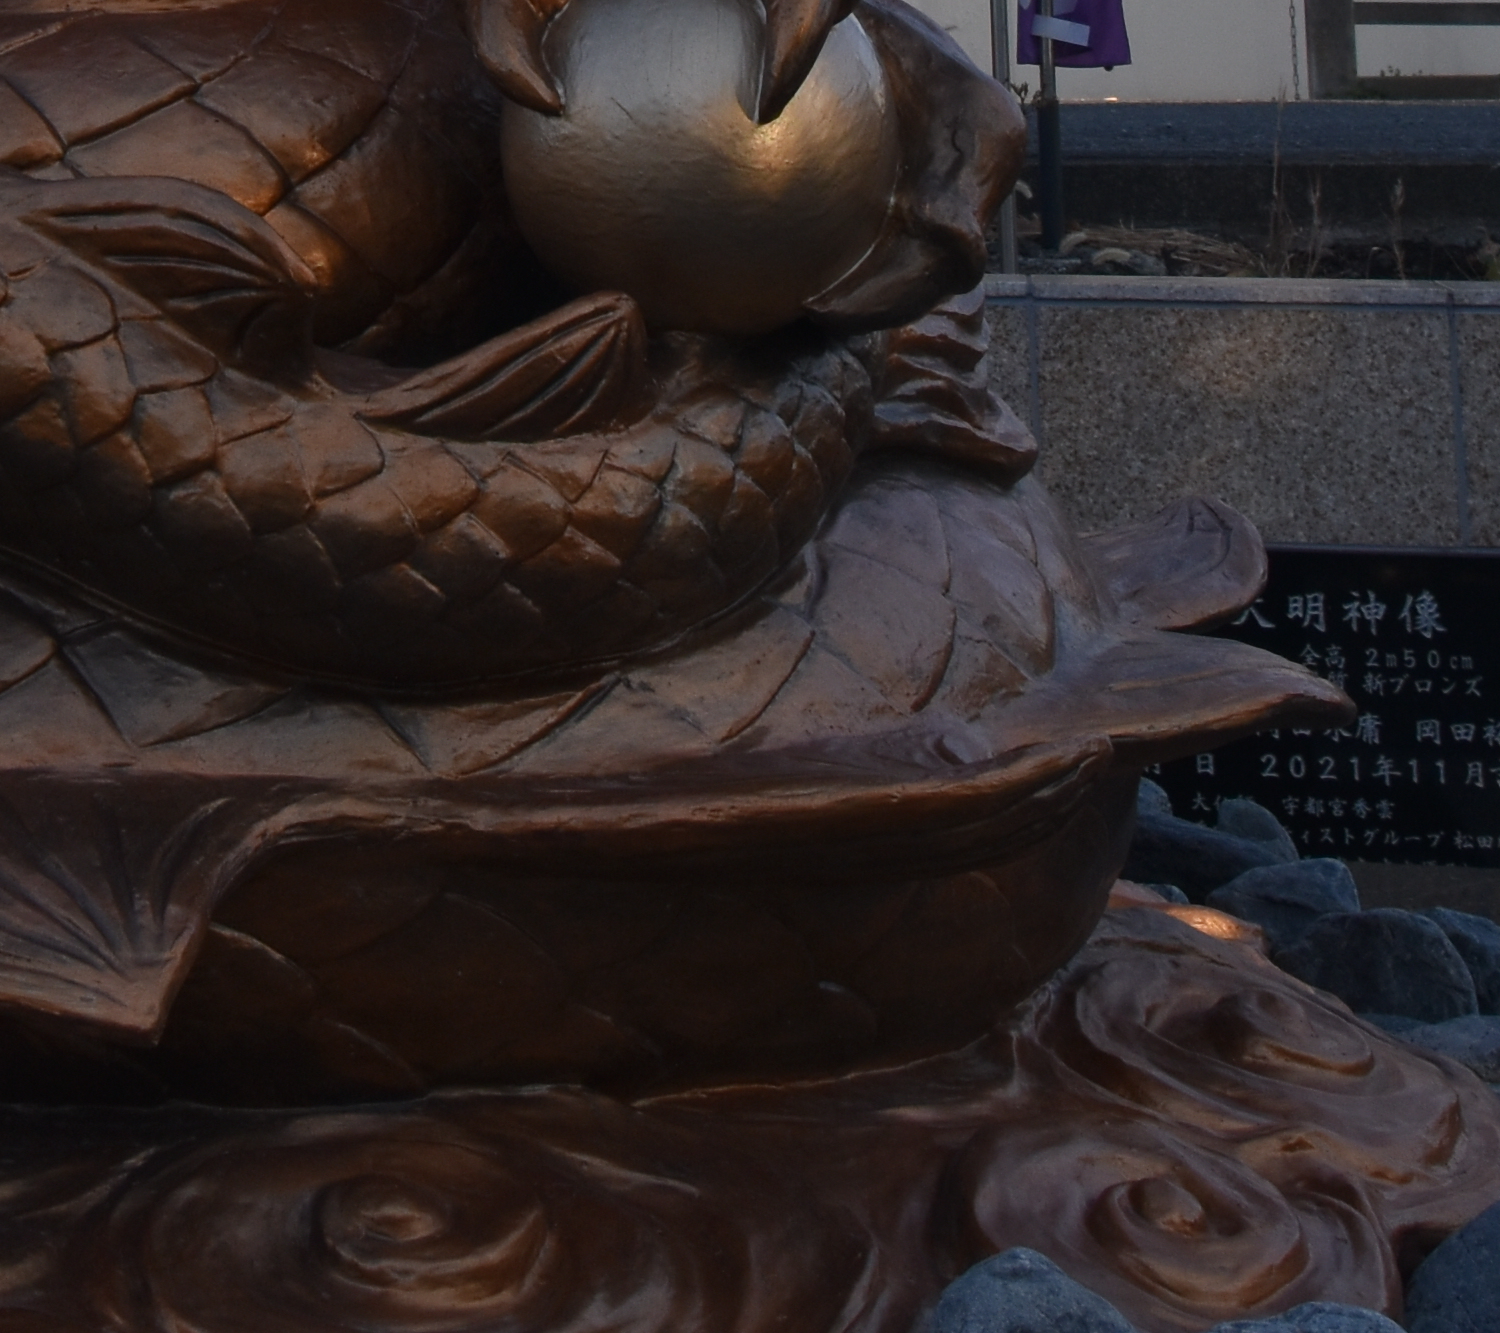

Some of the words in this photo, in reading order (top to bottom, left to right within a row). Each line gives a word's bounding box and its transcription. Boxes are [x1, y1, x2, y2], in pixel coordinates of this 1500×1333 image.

[1300, 643, 1346, 670] 全高
[1362, 671, 1484, 698] 新ブロンズ
